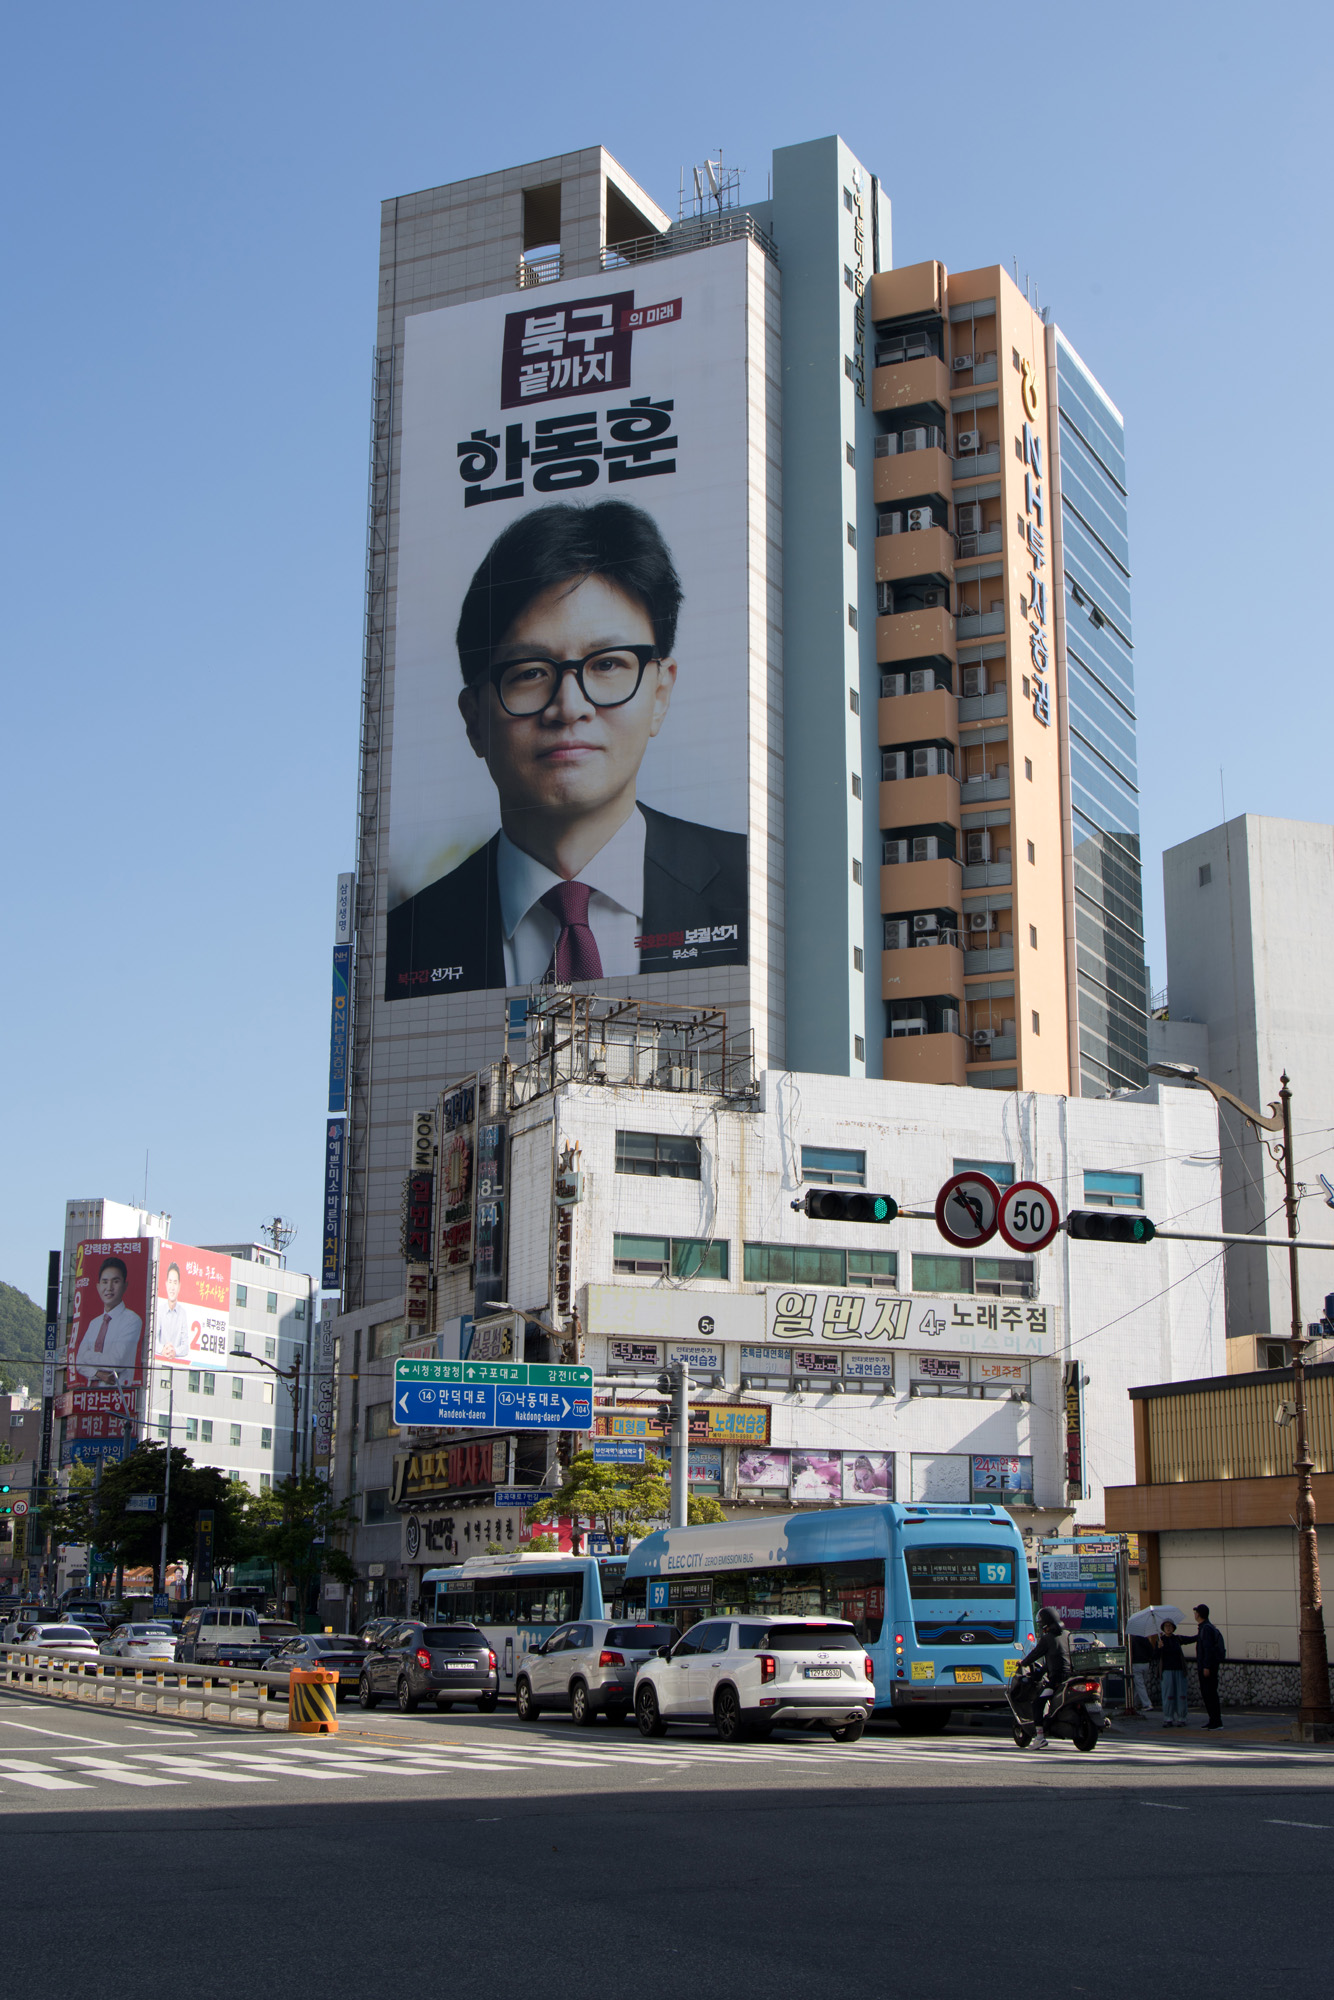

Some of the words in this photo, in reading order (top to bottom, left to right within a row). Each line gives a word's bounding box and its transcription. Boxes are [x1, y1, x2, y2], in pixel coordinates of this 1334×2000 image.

[520, 303, 615, 357] 북구
[628, 311, 643, 326] 의
[646, 302, 675, 323] 미래
[519, 351, 614, 397] 끝까지
[456, 396, 679, 509] 한동훈
[339, 883, 349, 932] 삼성생명
[672, 947, 698, 960] 무소속
[430, 966, 464, 983] 선거구
[415, 1112, 432, 1165] ROOM
[1013, 1200, 1045, 1233] 50
[84, 1243, 111, 1255] 강력한
[113, 1242, 142, 1254] 추진력
[76, 1245, 84, 1278] 2
[408, 1275, 428, 1318] 주점
[772, 1291, 912, 1341] 일번지
[918, 1309, 946, 1336] 4F
[951, 1303, 1047, 1333] 노래주점
[206, 1318, 226, 1332] 북구청장
[700, 1319, 714, 1333] 5F
[190, 1320, 201, 1351] 2
[200, 1333, 226, 1355] 오태원
[412, 1365, 460, 1377] 시청·경찰청
[478, 1367, 519, 1380] 구포대교
[548, 1370, 578, 1382] 감전IC
[846, 1363, 891, 1376] 노래연습장
[981, 1364, 1022, 1379] 노래주점
[1062, 1360, 1076, 1386] J
[421, 1391, 432, 1400] 14
[438, 1389, 486, 1406] 만덕대로
[501, 1394, 512, 1403] 14
[515, 1392, 561, 1408] 낙동대로
[438, 1408, 487, 1420] Mandeok-daero
[515, 1410, 561, 1423] Nakdong-daero
[575, 1406, 587, 1414] 104
[1066, 1386, 1080, 1433] 스포츠
[82, 1415, 103, 1436] 대한
[613, 1419, 647, 1436] 대형룸
[714, 1412, 767, 1434] 노래연습장
[688, 1454, 719, 1464] 스포츠
[975, 1456, 1020, 1474] 24시연중
[388, 1453, 410, 1505] J
[406, 1450, 449, 1493] 스포츠
[448, 1443, 493, 1488] 마사지
[707, 1469, 719, 1479] 2F
[985, 1474, 1011, 1489] 2F
[205, 1535, 211, 1546] 5
[667, 1554, 686, 1570] ELEC
[686, 1553, 704, 1568] CITY
[704, 1557, 718, 1566] ZERO
[718, 1555, 742, 1566] EMISSION
[742, 1553, 754, 1563] BUS
[987, 1565, 1006, 1581] 59
[654, 1587, 665, 1604] 59
[1102, 1605, 1115, 1619] 북구
[961, 1673, 981, 1681] 2657
